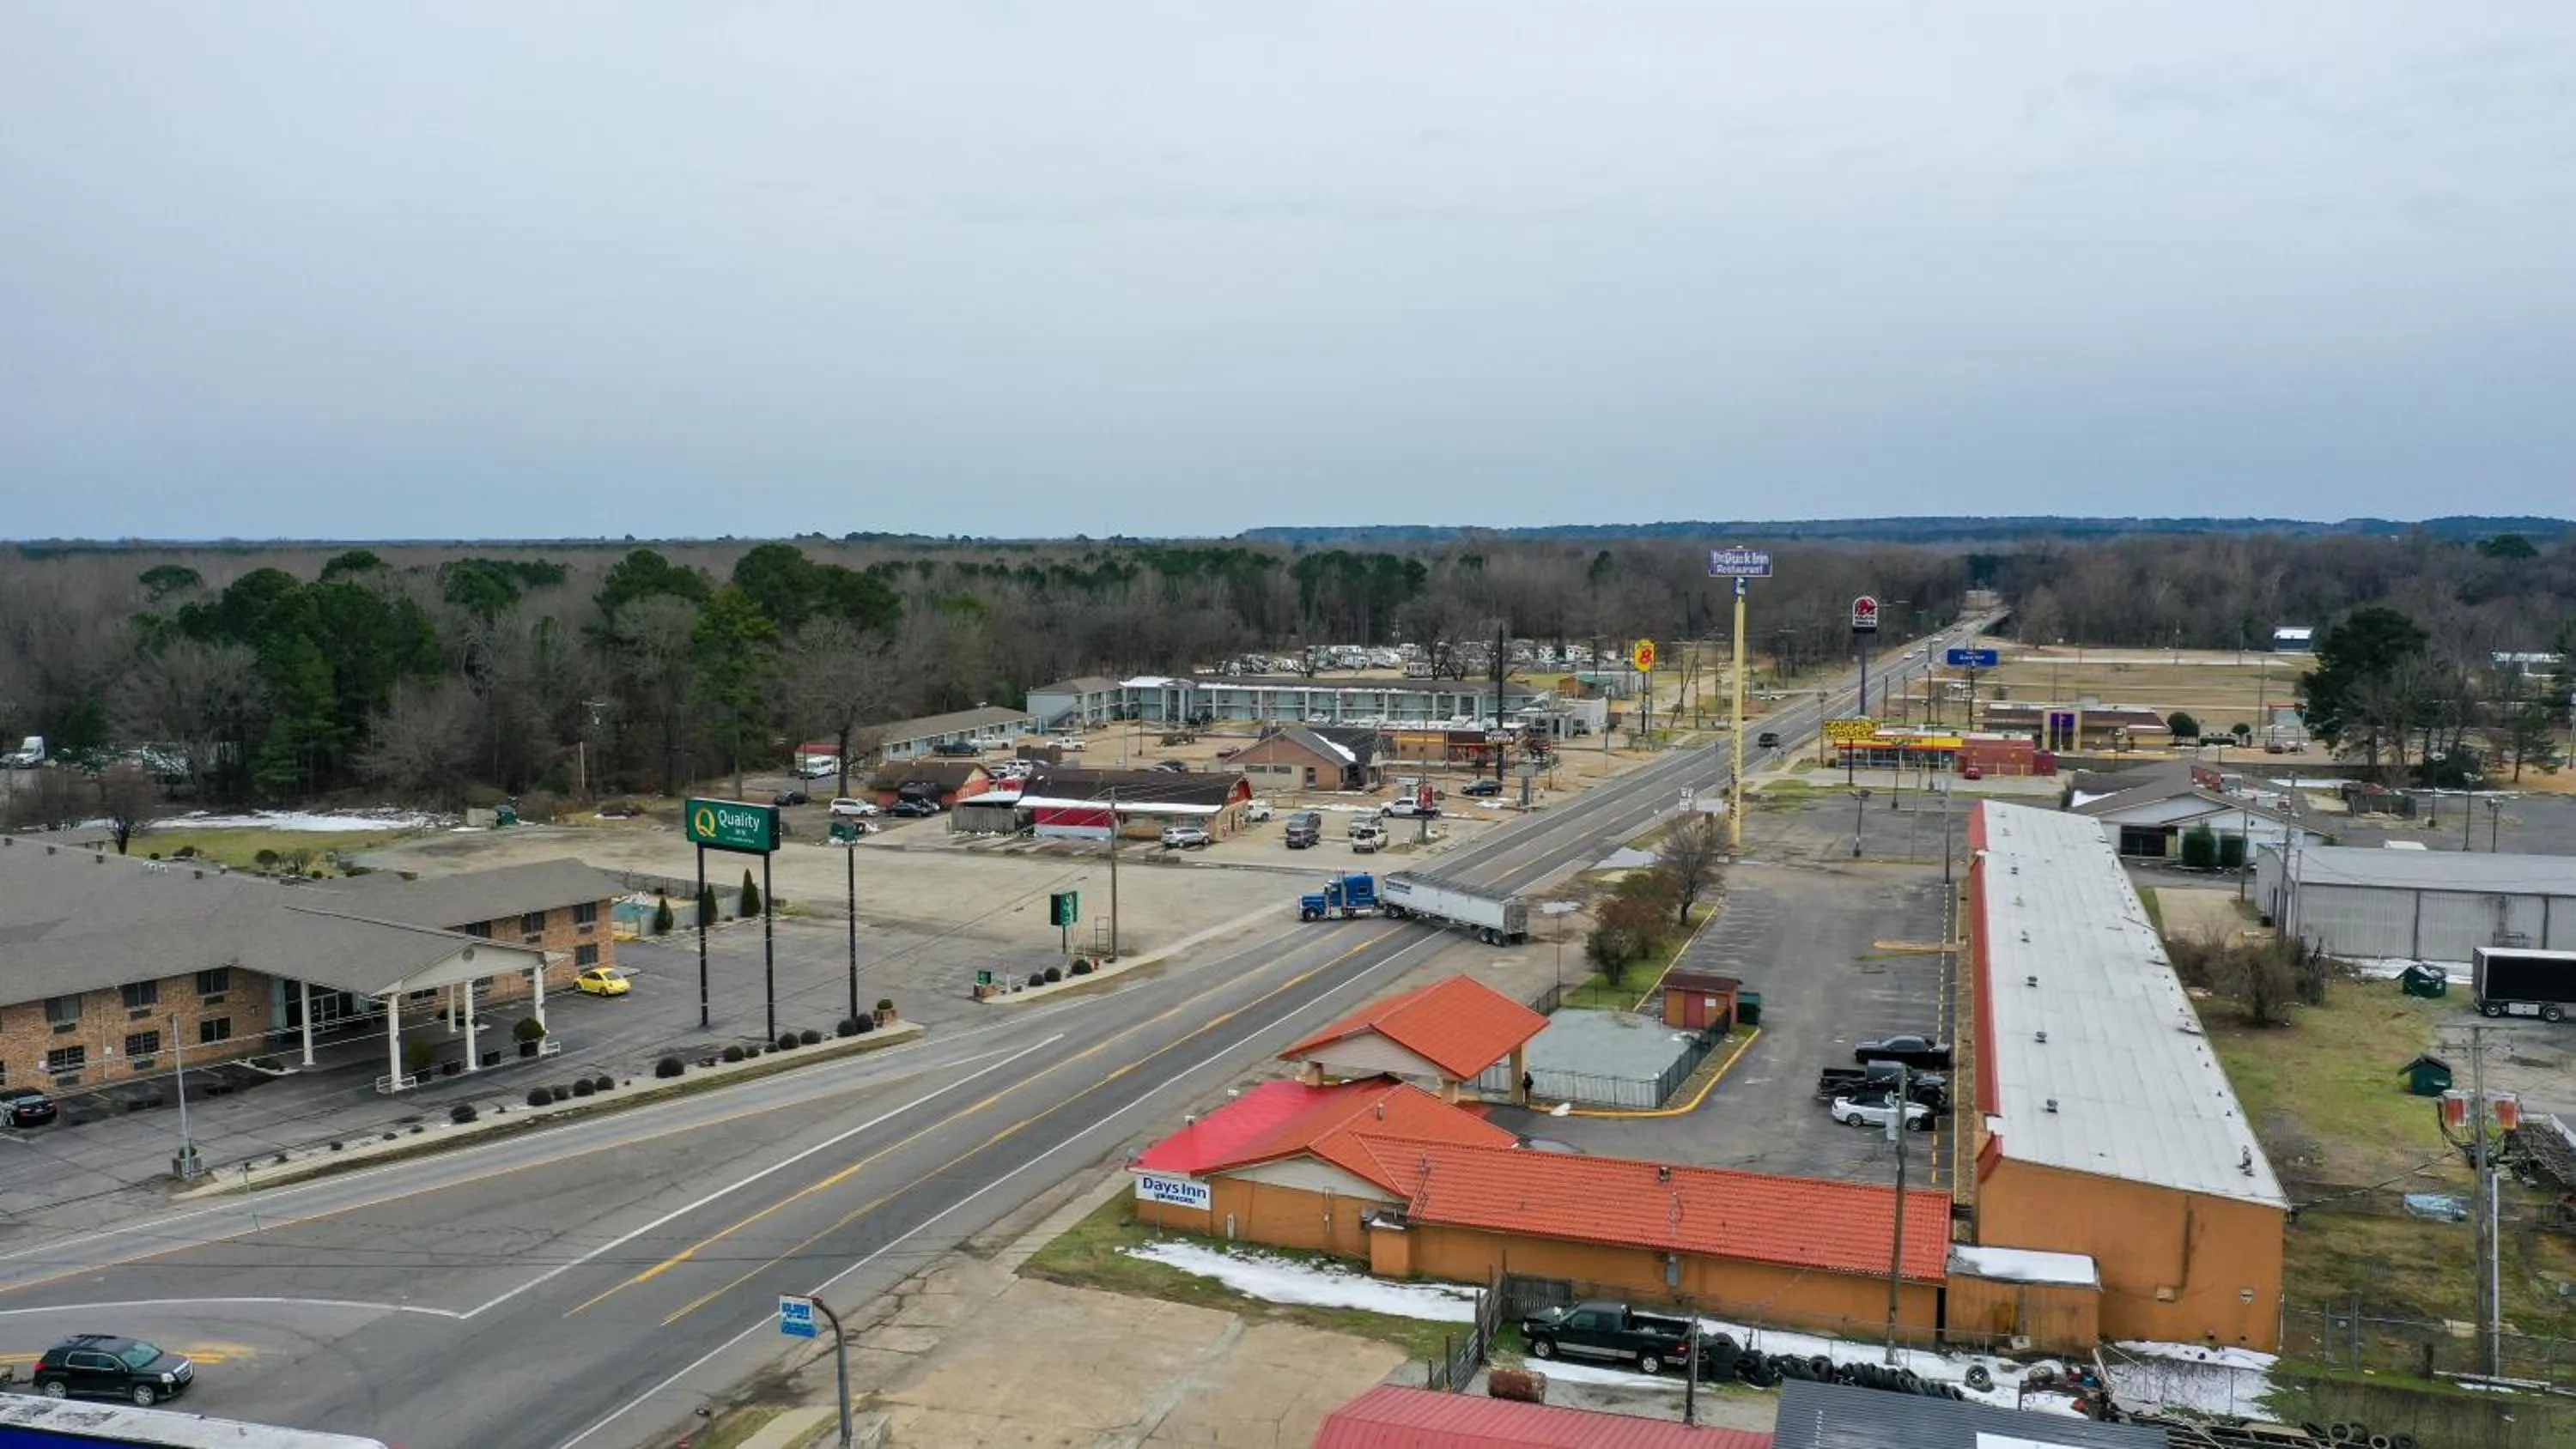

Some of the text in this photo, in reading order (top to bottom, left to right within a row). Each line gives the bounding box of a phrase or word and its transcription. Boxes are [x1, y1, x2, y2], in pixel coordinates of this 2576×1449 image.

[718, 809, 760, 832] Quality
[1143, 1177, 1179, 1194] Days
[1182, 1183, 1206, 1198] Inn
